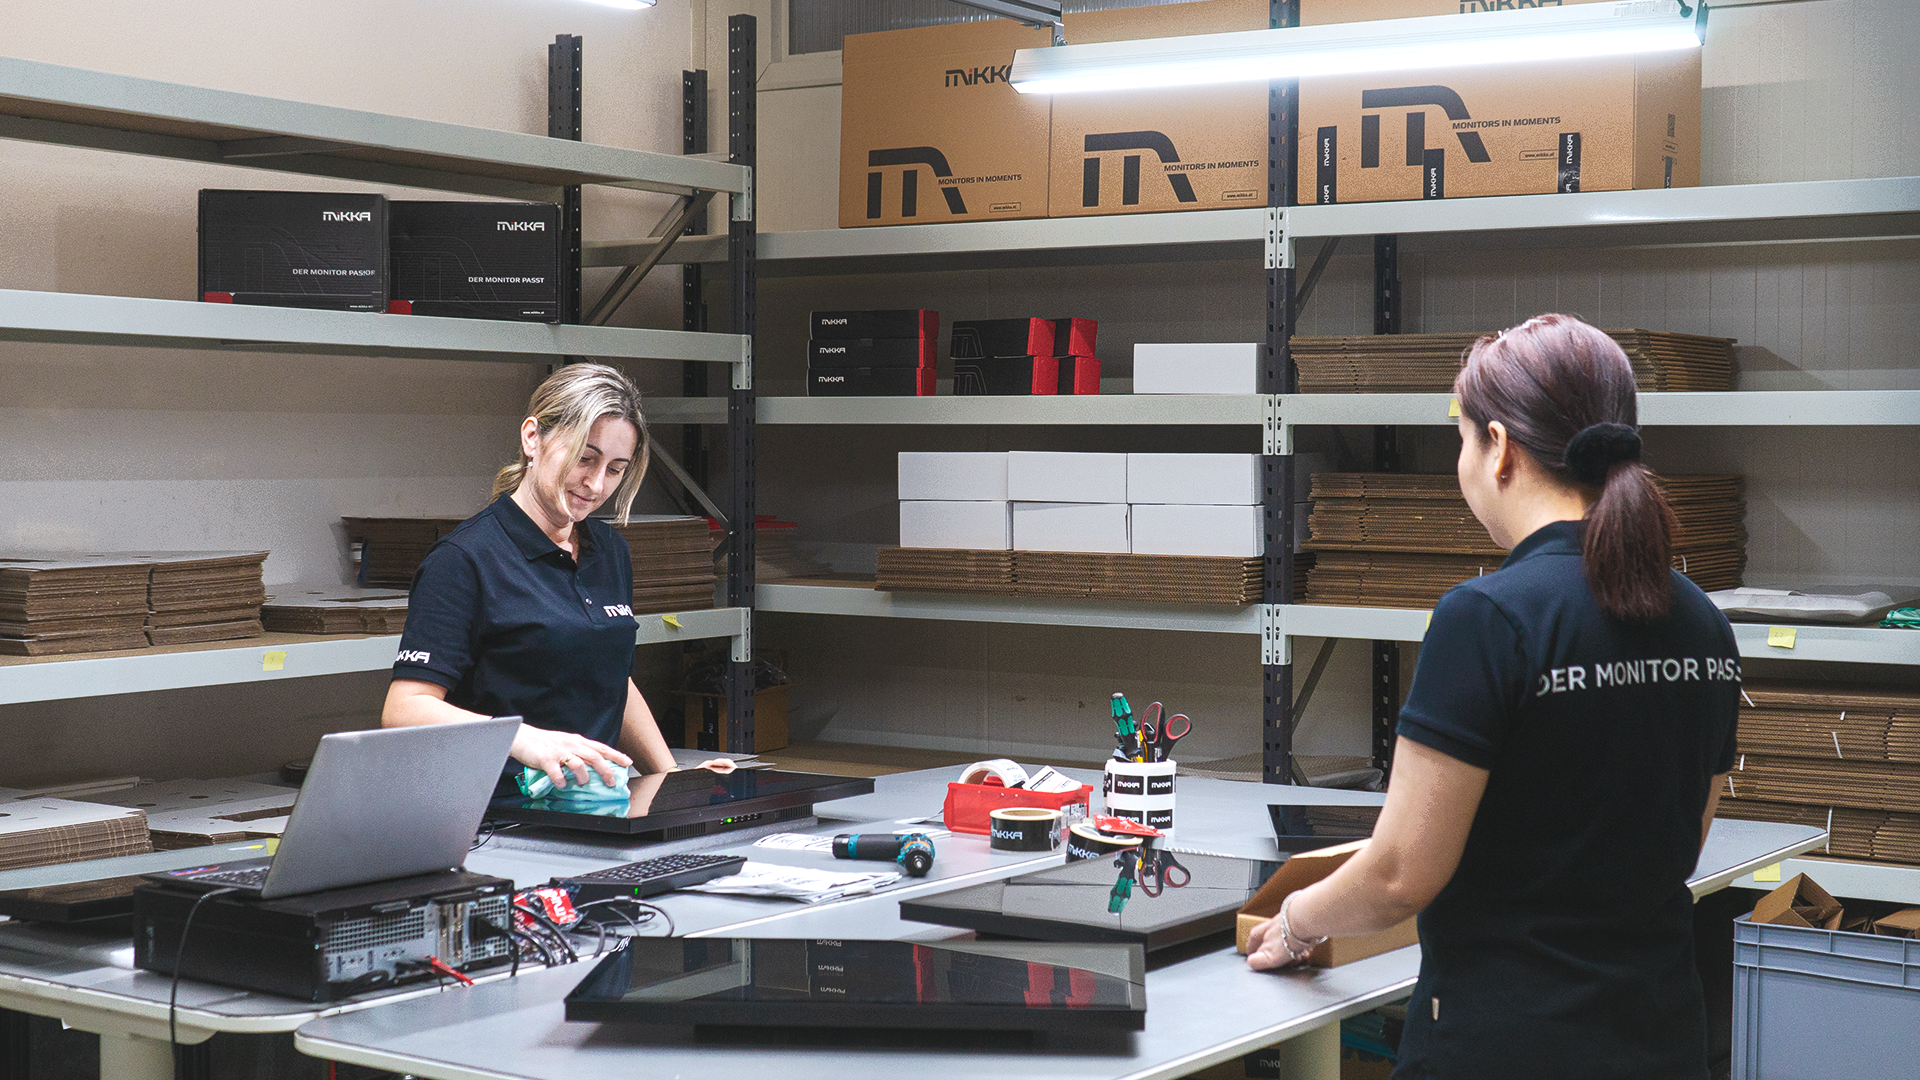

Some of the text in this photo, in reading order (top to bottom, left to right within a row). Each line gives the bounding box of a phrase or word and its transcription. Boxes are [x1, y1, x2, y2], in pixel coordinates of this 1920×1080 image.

[1452, 115, 1561, 130] MONITORS IN MOMENTS
[1164, 160, 1260, 172] MONITORS IN MOMENTS
[938, 173, 1022, 186] MONITORS IN MOMENTS
[310, 268, 348, 276] MONITOR
[485, 276, 521, 284] MONITOR
[1595, 657, 1700, 688] MONITOR
